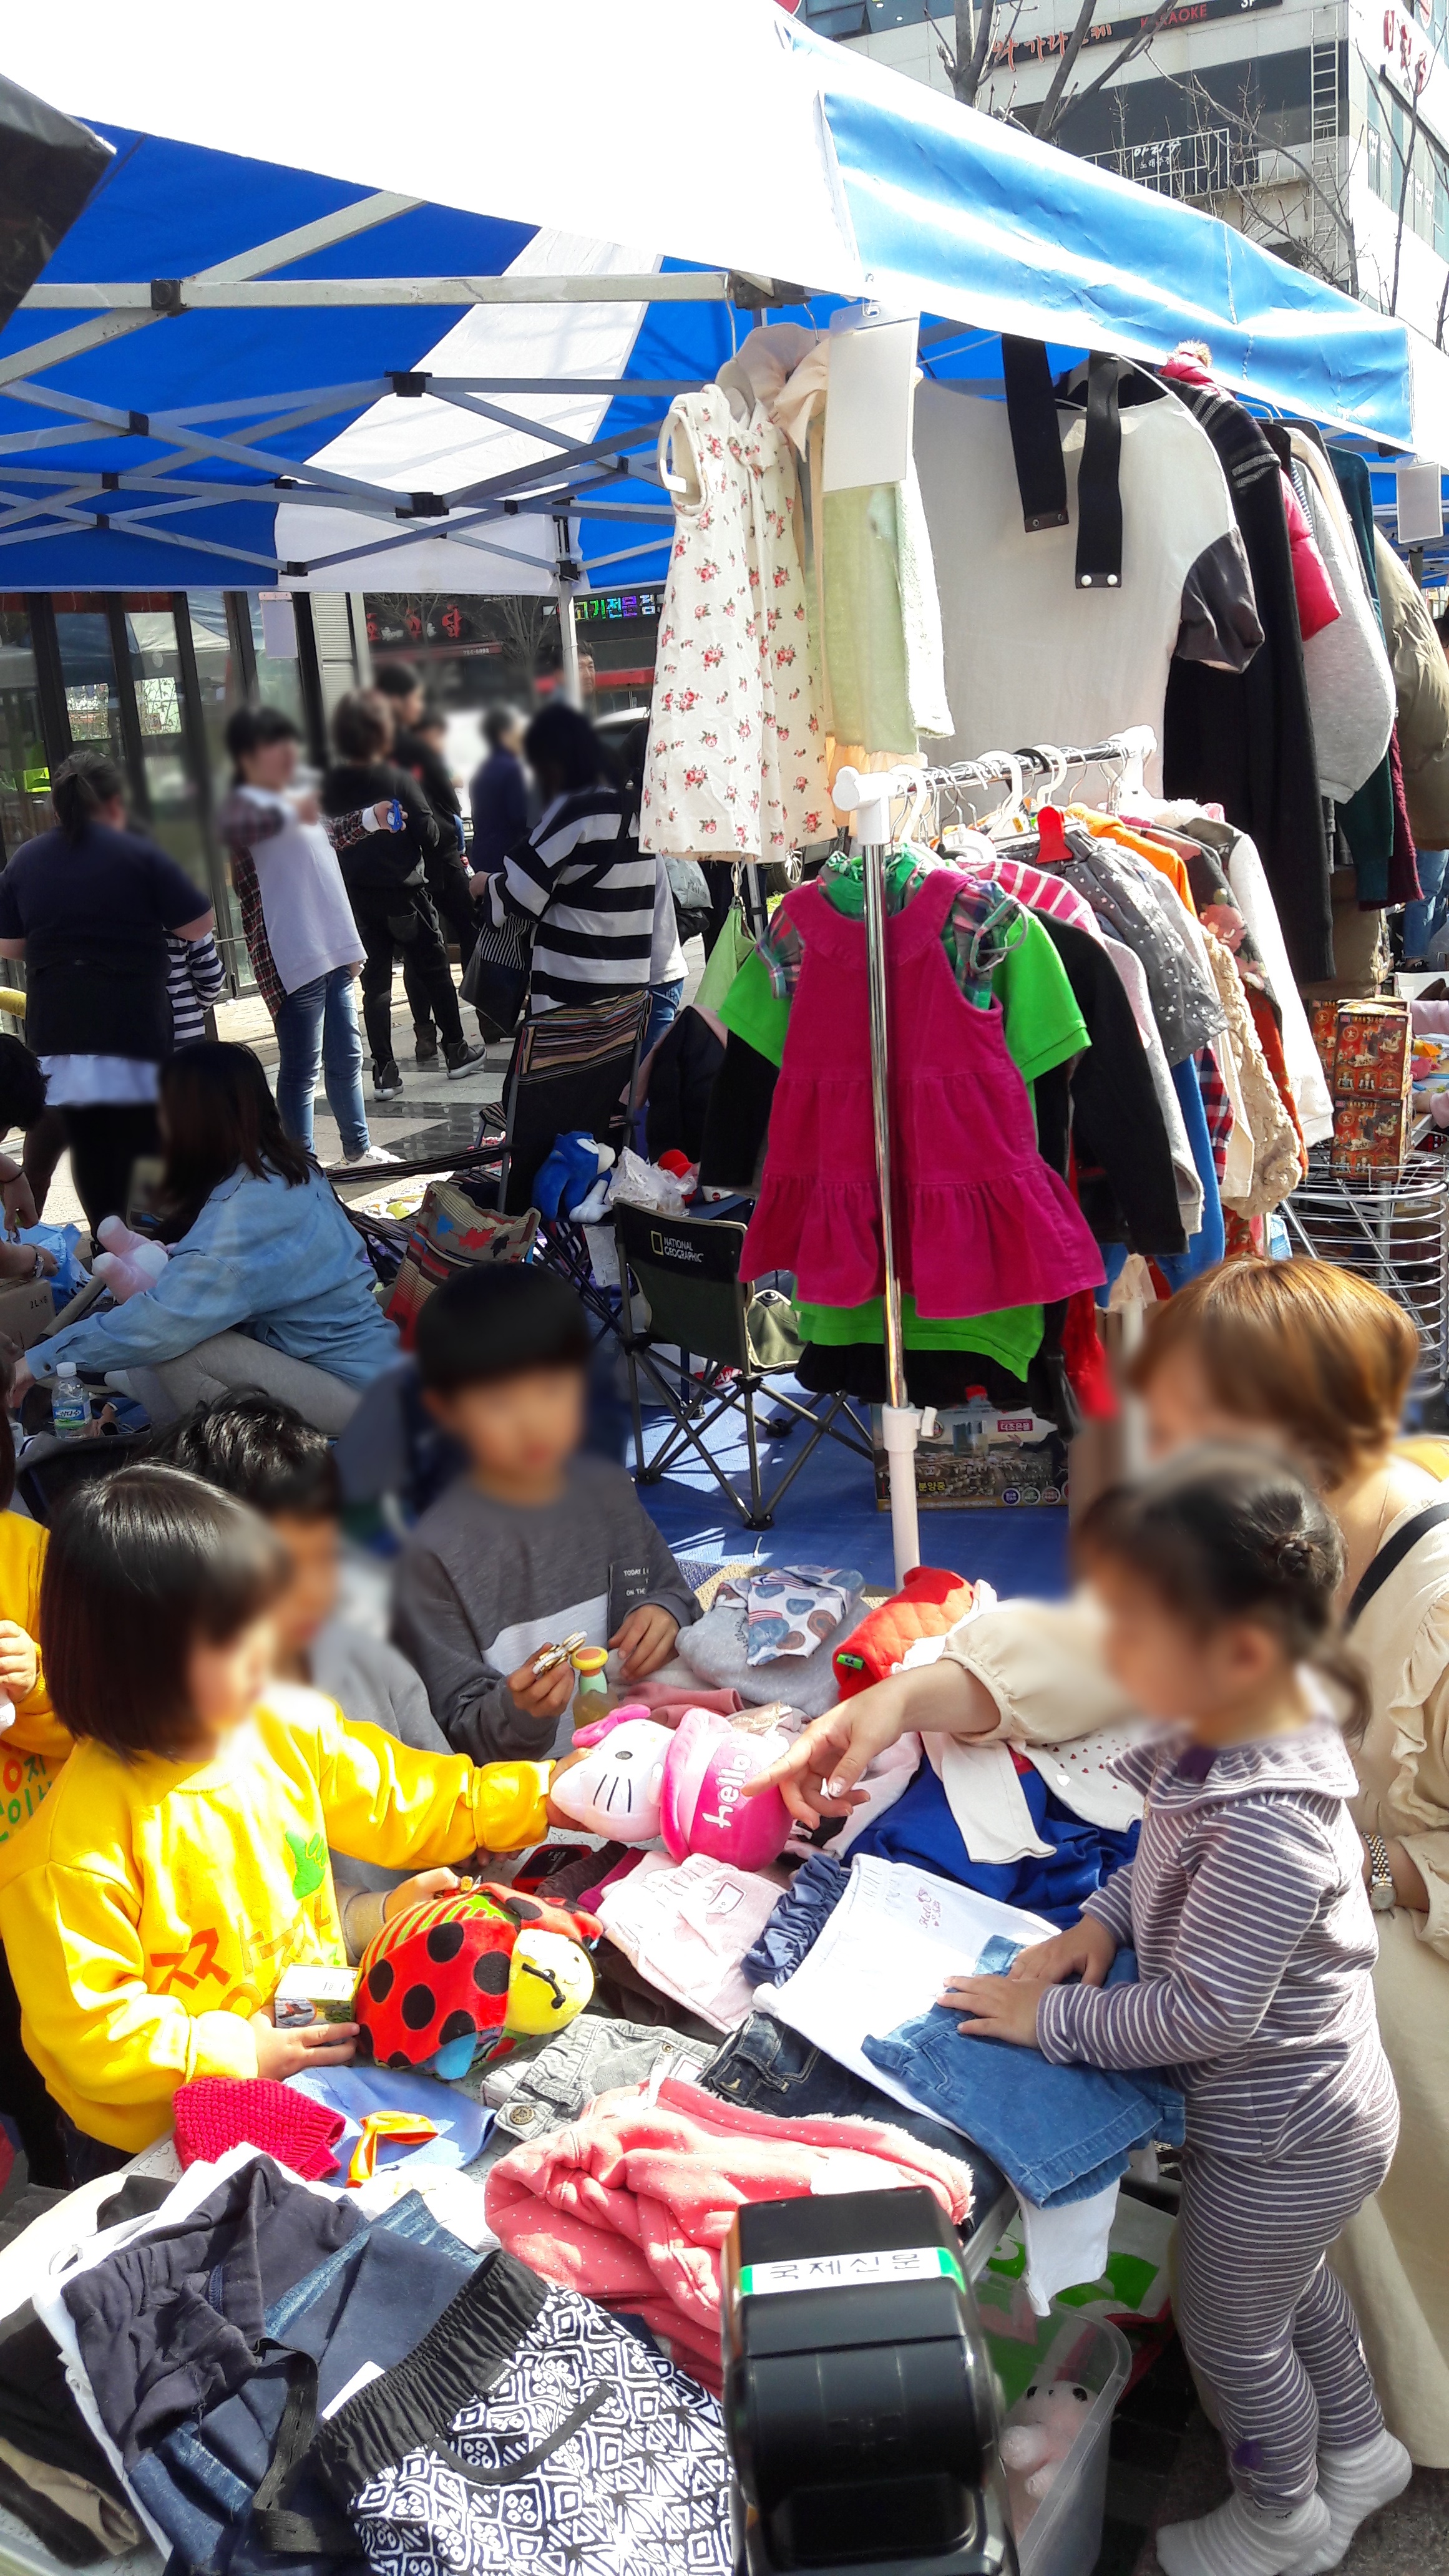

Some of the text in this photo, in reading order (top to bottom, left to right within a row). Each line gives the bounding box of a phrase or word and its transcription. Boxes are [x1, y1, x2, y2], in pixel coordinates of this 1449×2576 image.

[1024, 22, 1112, 63] 가라케
[663, 1236, 694, 1251] NATIONAL
[664, 1246, 705, 1262] GEOGRAPHIC
[623, 1568, 642, 1577] TODAY
